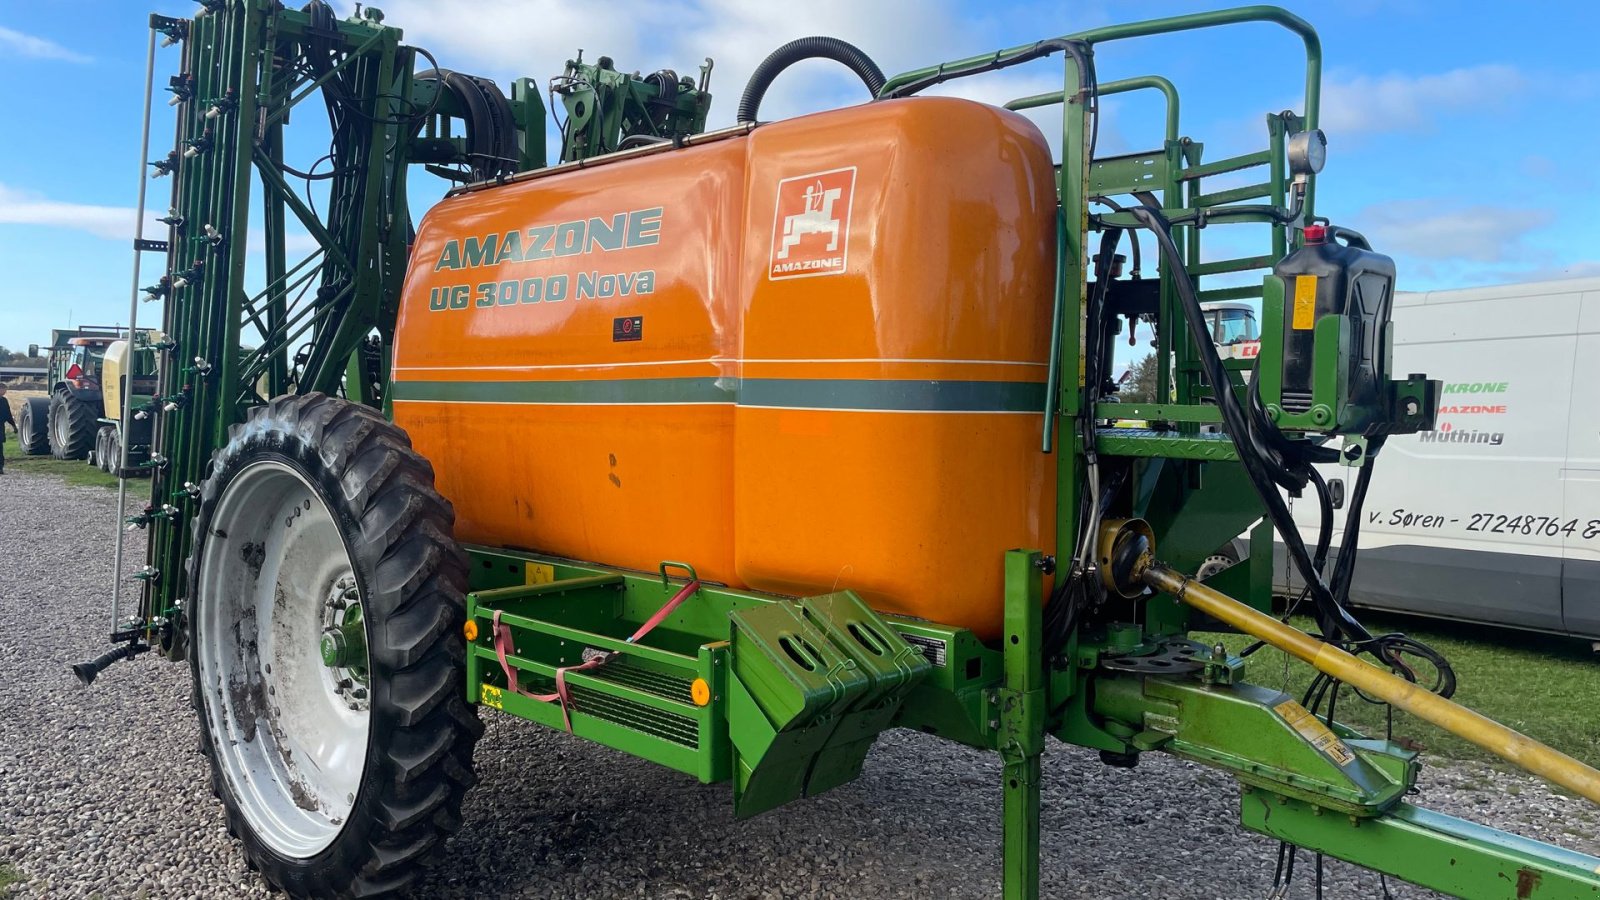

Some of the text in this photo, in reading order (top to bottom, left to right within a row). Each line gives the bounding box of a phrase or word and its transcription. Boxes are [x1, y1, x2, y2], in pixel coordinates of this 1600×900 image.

[434, 207, 664, 273] AMAZONE
[772, 257, 842, 274] AMAZONE
[428, 269, 655, 312] UG 3000 Nova
[1444, 383, 1508, 394] KRONE
[1437, 405, 1507, 414] MAZONE
[1369, 511, 1383, 525] v.
[1389, 508, 1445, 528] Søren
[1466, 513, 1579, 538] 27248764
